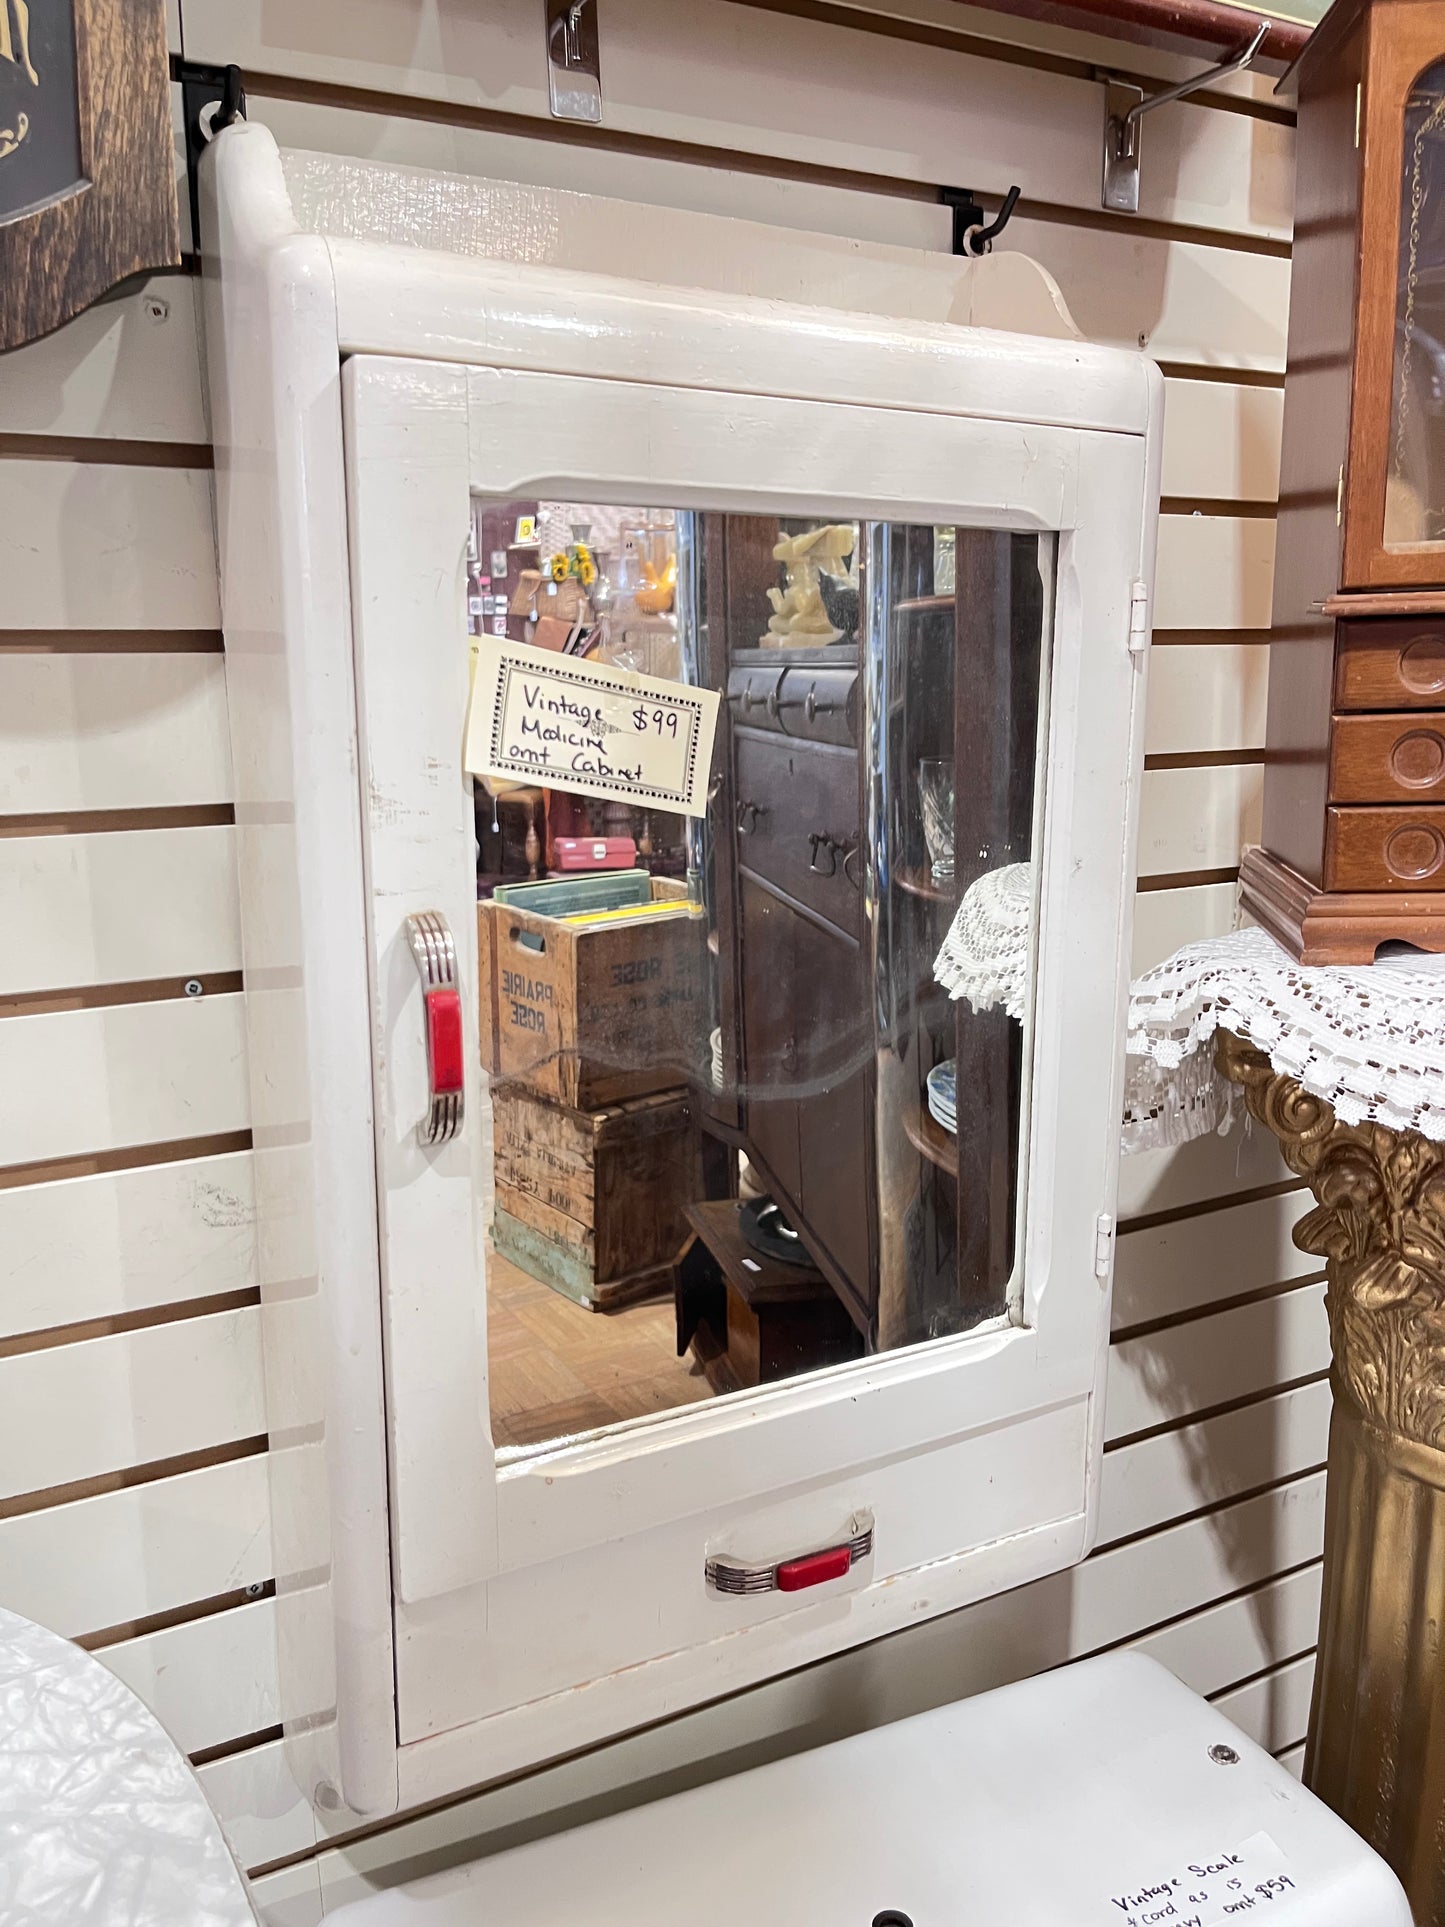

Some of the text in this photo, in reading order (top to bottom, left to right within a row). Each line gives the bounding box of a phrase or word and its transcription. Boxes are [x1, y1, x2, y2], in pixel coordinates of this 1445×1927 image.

[523, 684, 678, 738] Vintage $99
[571, 752, 644, 781] Cabinet
[1111, 1854, 1245, 1911] Vintage Scale
[1188, 1891, 1208, 1903] as
[1254, 1875, 1296, 1900] $59
